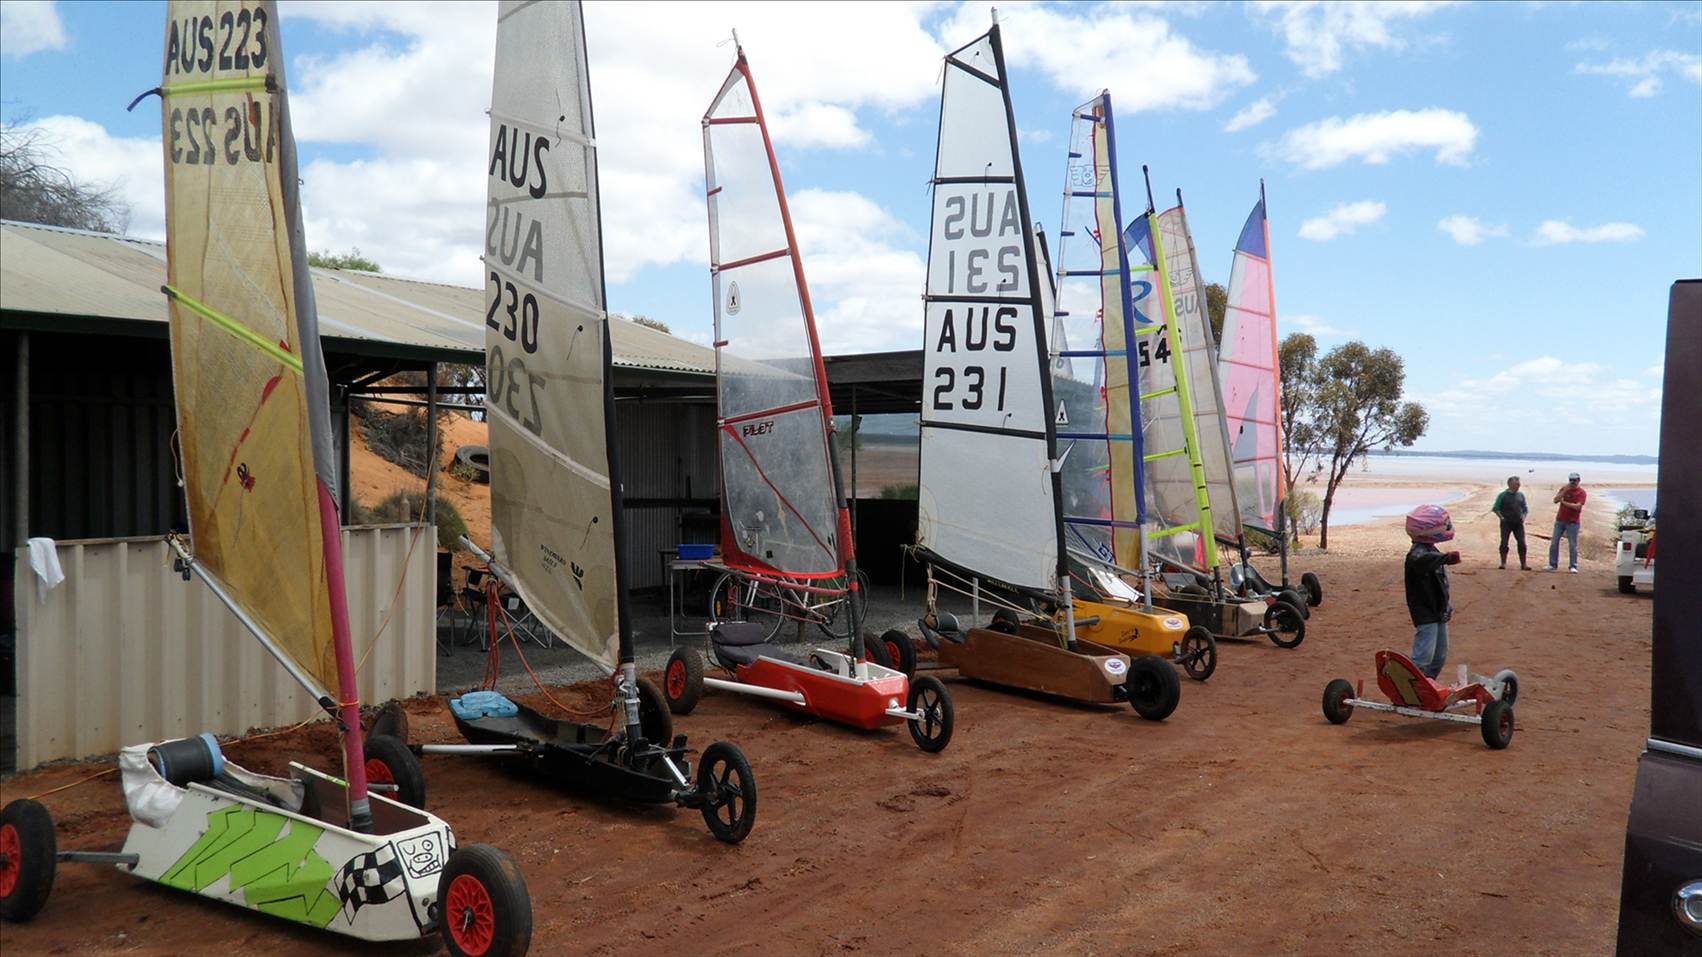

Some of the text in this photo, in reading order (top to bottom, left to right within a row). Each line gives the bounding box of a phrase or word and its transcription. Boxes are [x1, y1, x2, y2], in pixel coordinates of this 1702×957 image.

[165, 6, 267, 76] AUS 223
[489, 123, 550, 199] AUS
[486, 271, 540, 354] 230
[936, 307, 1018, 353] AUS
[933, 365, 1007, 412] 231
